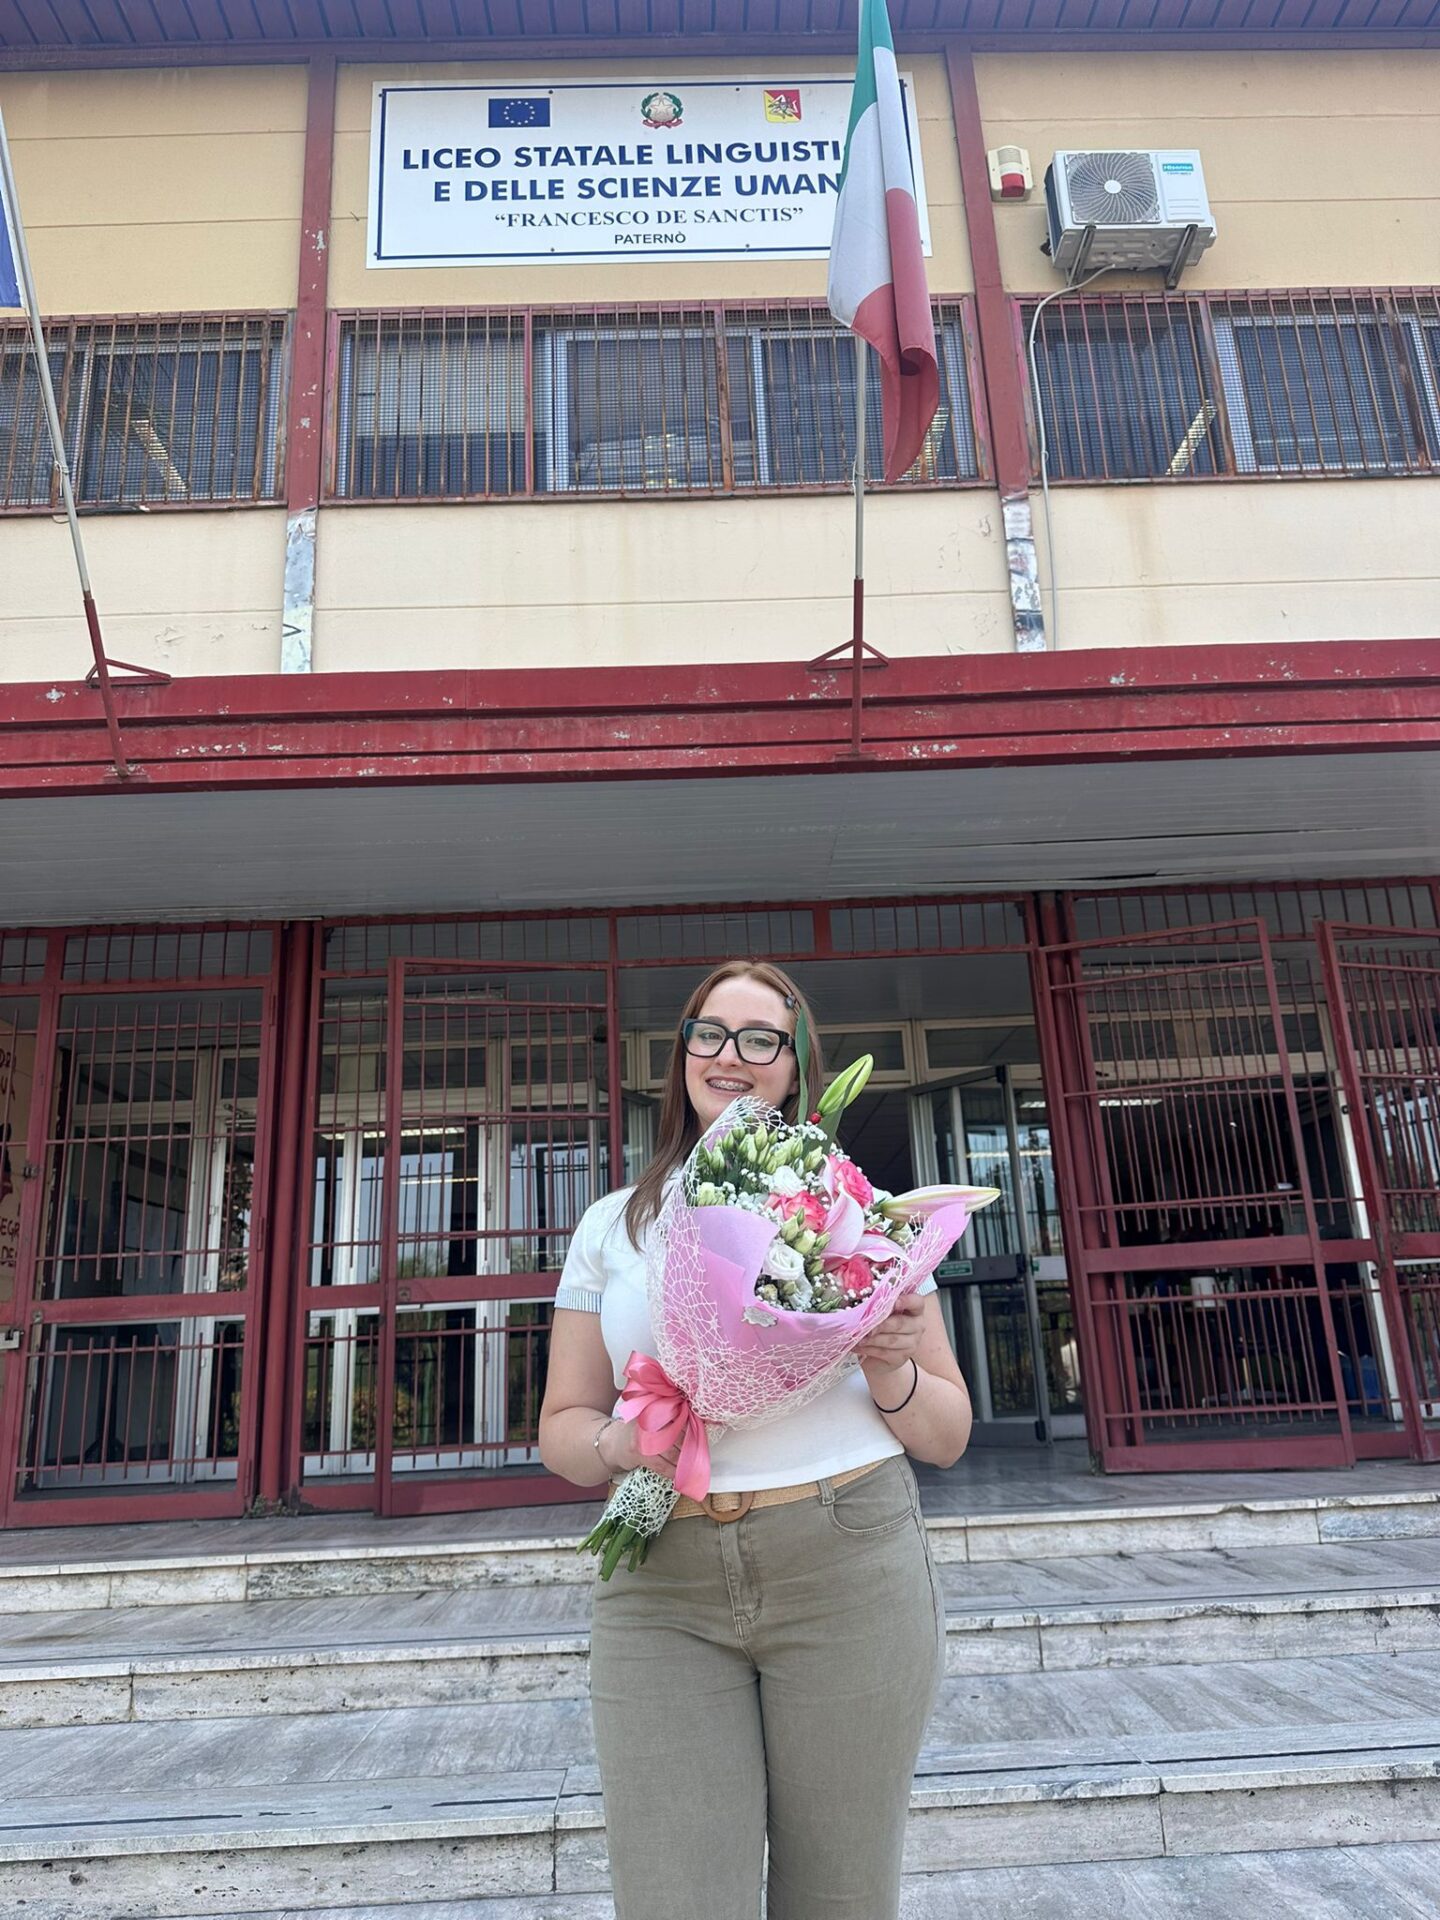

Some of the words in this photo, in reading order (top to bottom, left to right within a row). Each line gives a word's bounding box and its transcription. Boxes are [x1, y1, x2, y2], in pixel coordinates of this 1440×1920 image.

[403, 148, 501, 170] LICEO
[514, 145, 653, 168] STATALE
[667, 141, 841, 165] LINGUISTI
[434, 181, 451, 202] E
[465, 179, 564, 201] DELLE
[577, 176, 721, 200] SCIENZE
[735, 173, 840, 196] UMAN
[495, 210, 649, 228] “FRANCESCO
[657, 210, 687, 225] DE
[694, 207, 803, 224] SANCTIS”
[615, 231, 686, 244] PATERNÒ
